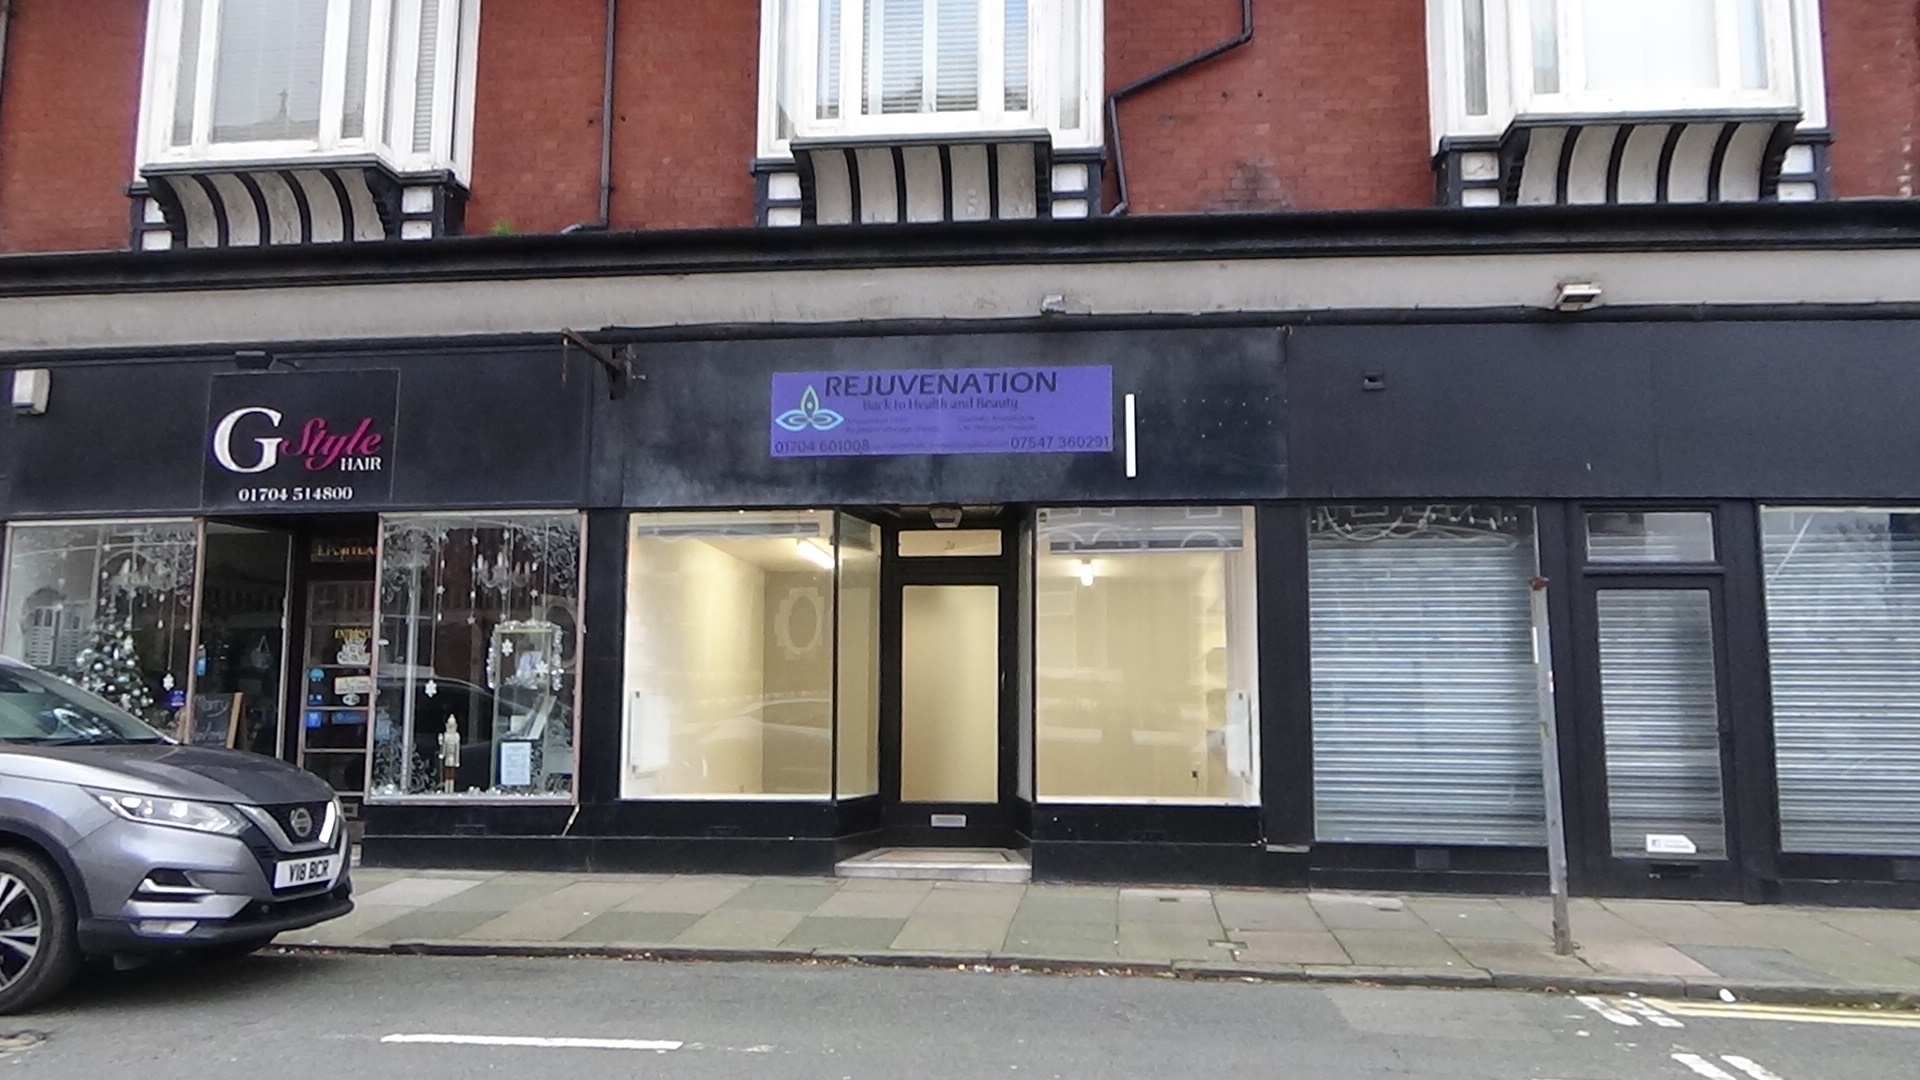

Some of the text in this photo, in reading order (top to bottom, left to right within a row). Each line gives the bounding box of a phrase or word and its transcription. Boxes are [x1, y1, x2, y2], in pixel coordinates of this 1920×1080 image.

[823, 371, 1058, 397] REJUVENATION
[862, 396, 1019, 412] Back to Health and Beauty
[213, 406, 383, 474] G Style
[774, 440, 815, 454] 01704
[1010, 435, 1054, 450] 07547
[1058, 435, 1110, 449] 360291
[340, 456, 382, 472] HAIR
[238, 486, 353, 502] 01704 514800
